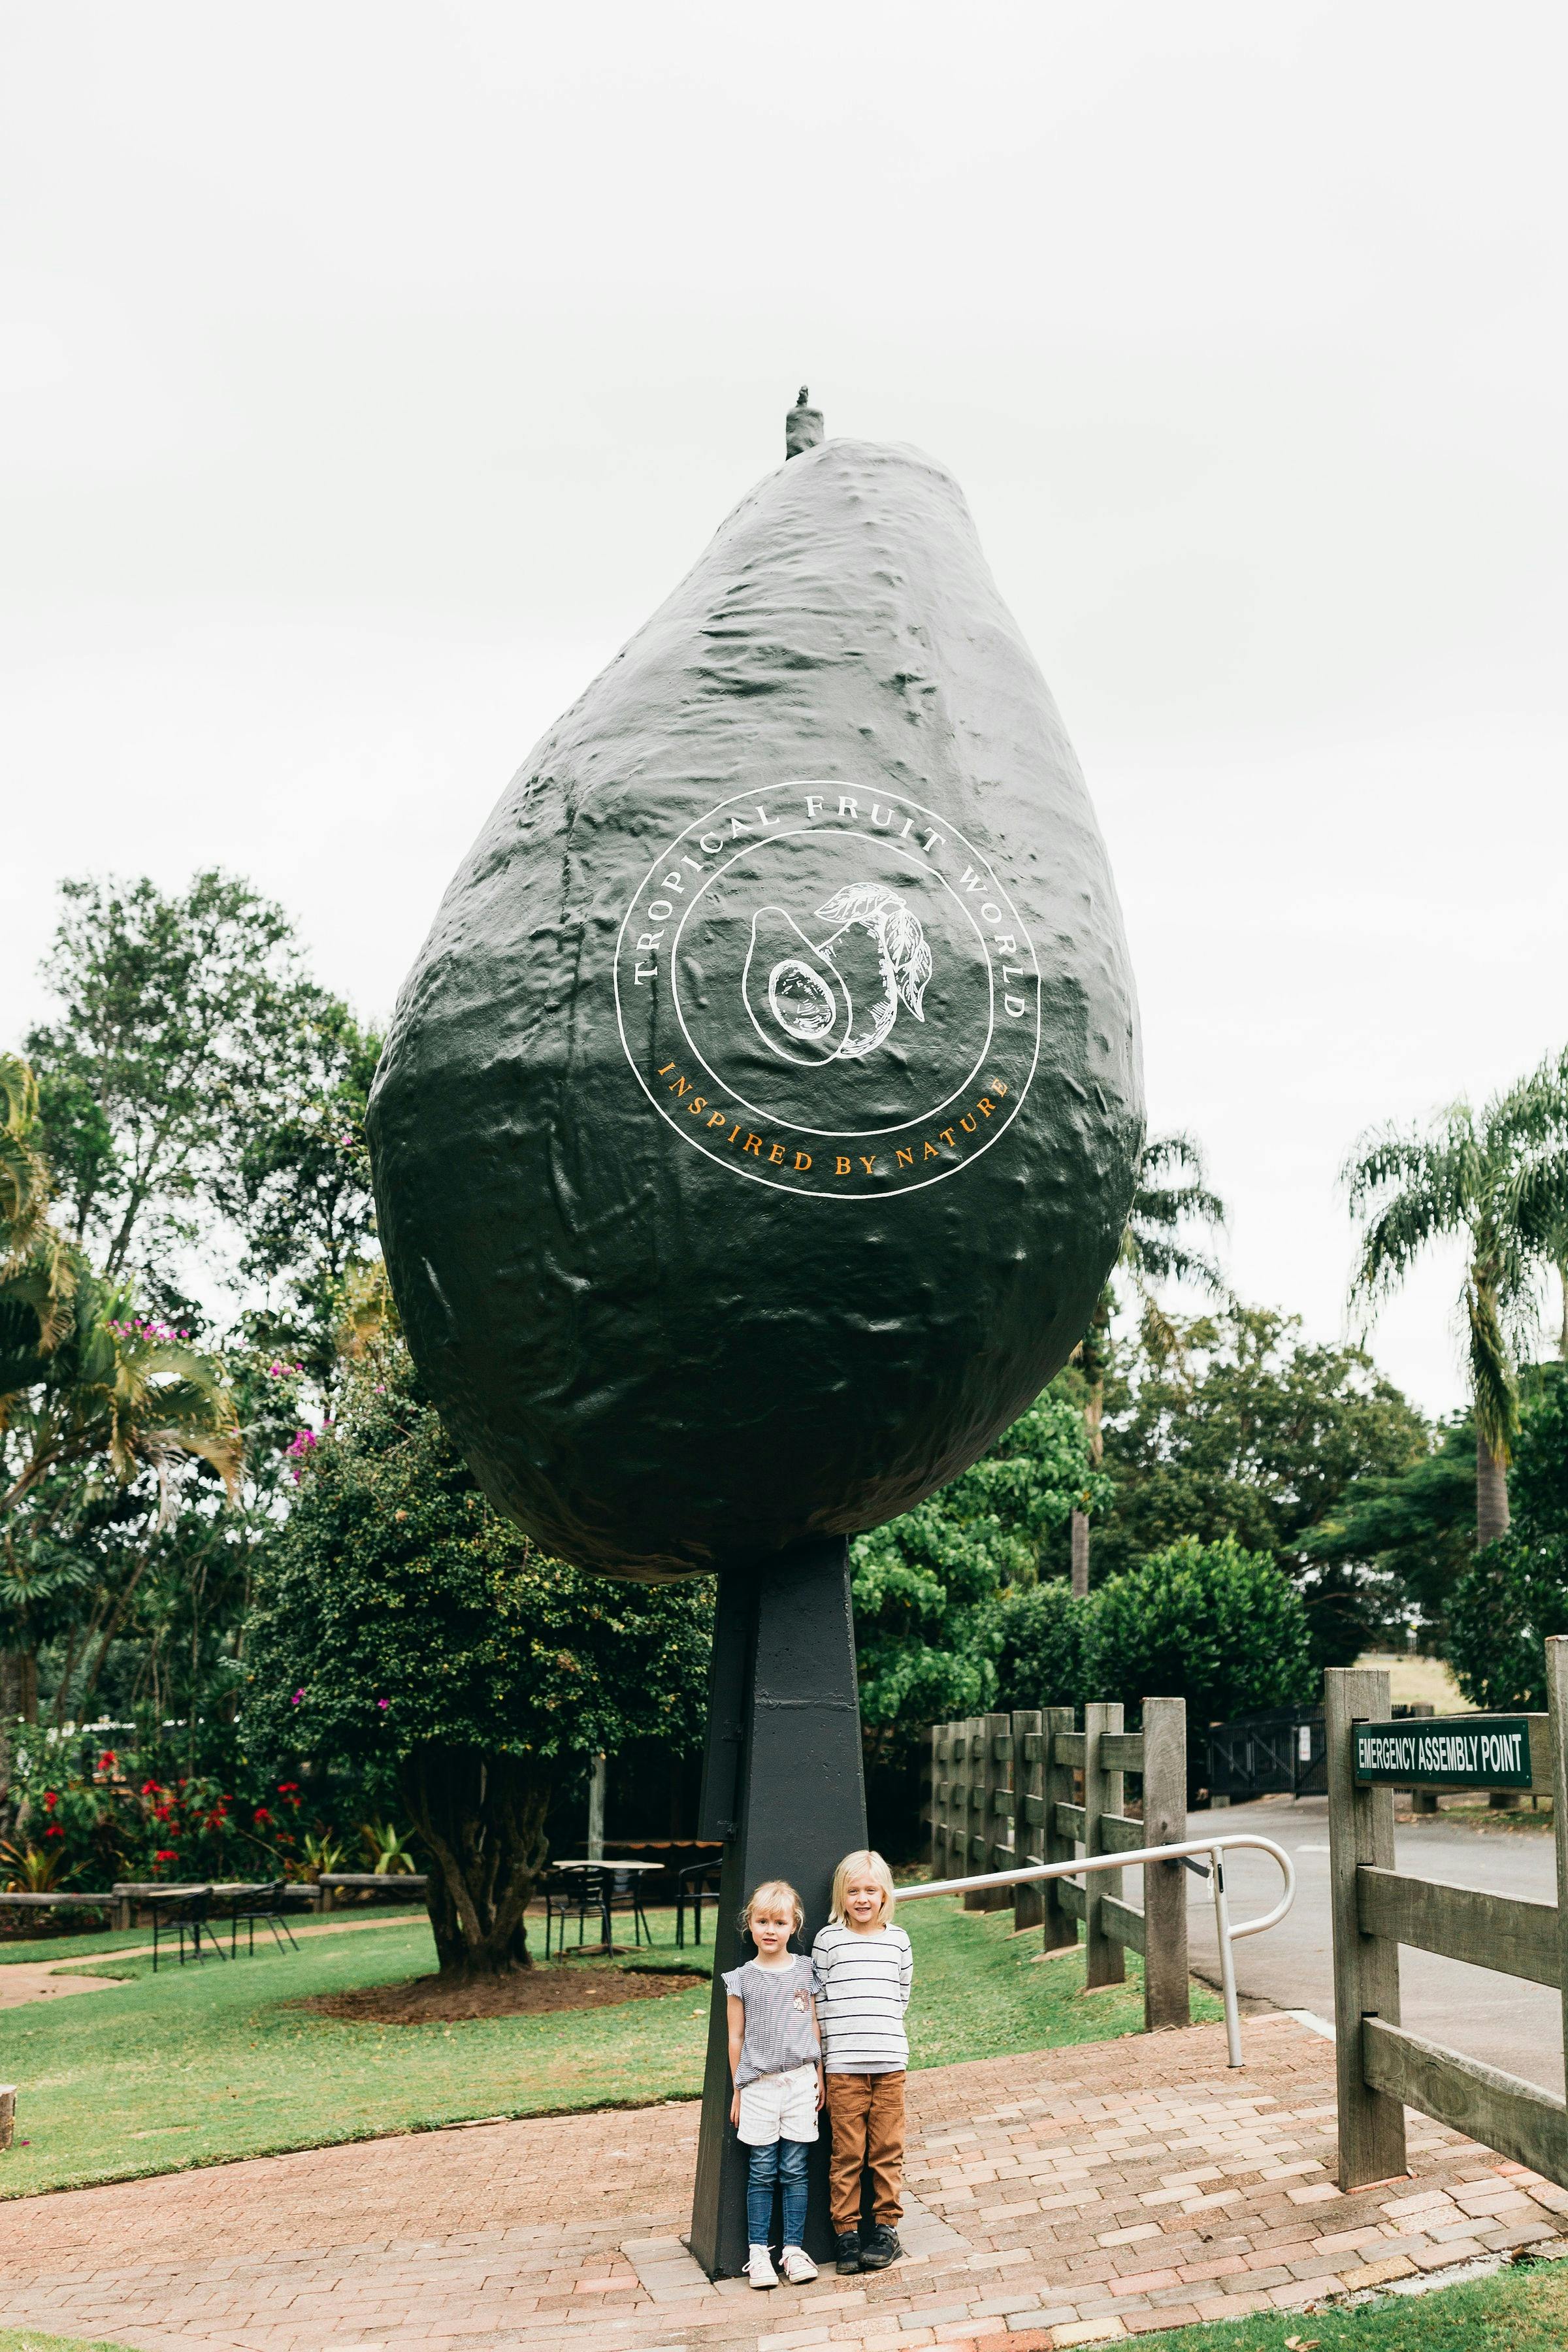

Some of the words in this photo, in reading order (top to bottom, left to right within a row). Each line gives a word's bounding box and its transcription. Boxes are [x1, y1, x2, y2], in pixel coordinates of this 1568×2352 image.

[634, 804, 781, 985] TROPICAL
[804, 795, 946, 854] FRUIT
[959, 865, 1026, 1019] WORLD
[658, 1061, 813, 1171] INSPIRED
[835, 1155, 877, 1175] BY
[896, 1078, 1008, 1168] NATURE
[1359, 1737, 1415, 1770] EMERGENCY
[1418, 1736, 1478, 1771] ASSEMBLY
[1481, 1733, 1522, 1772] POINT
